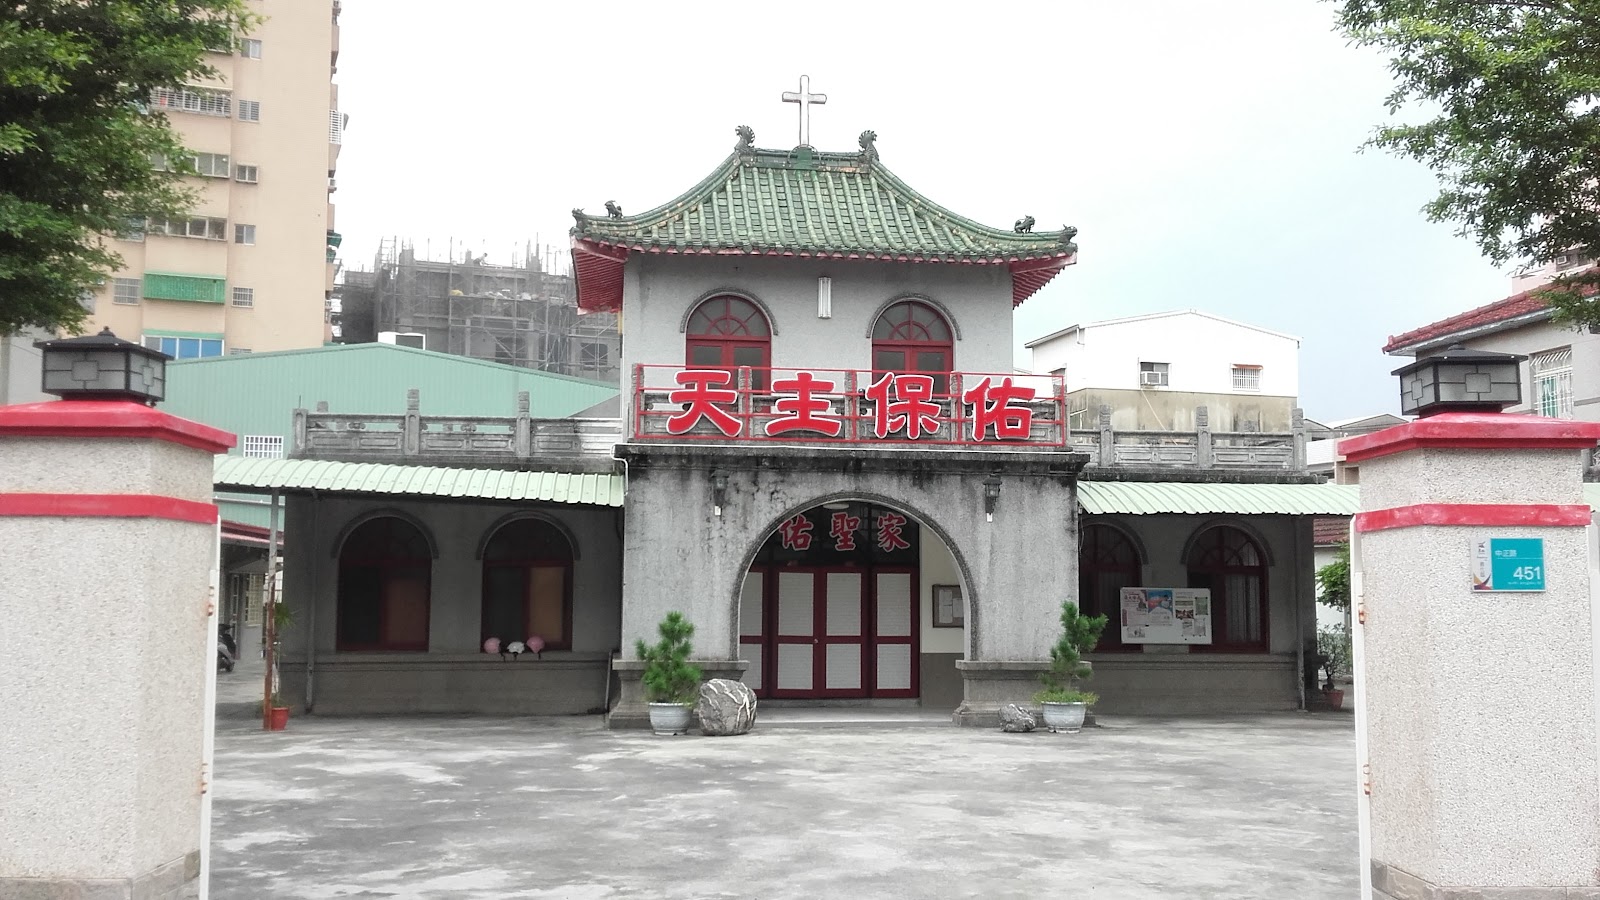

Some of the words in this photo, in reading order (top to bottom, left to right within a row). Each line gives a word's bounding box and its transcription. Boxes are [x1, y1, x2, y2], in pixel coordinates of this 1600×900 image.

[666, 370, 1036, 442] 天主保佑
[778, 512, 910, 552] 佑聖家
[1513, 566, 1541, 580] 451
